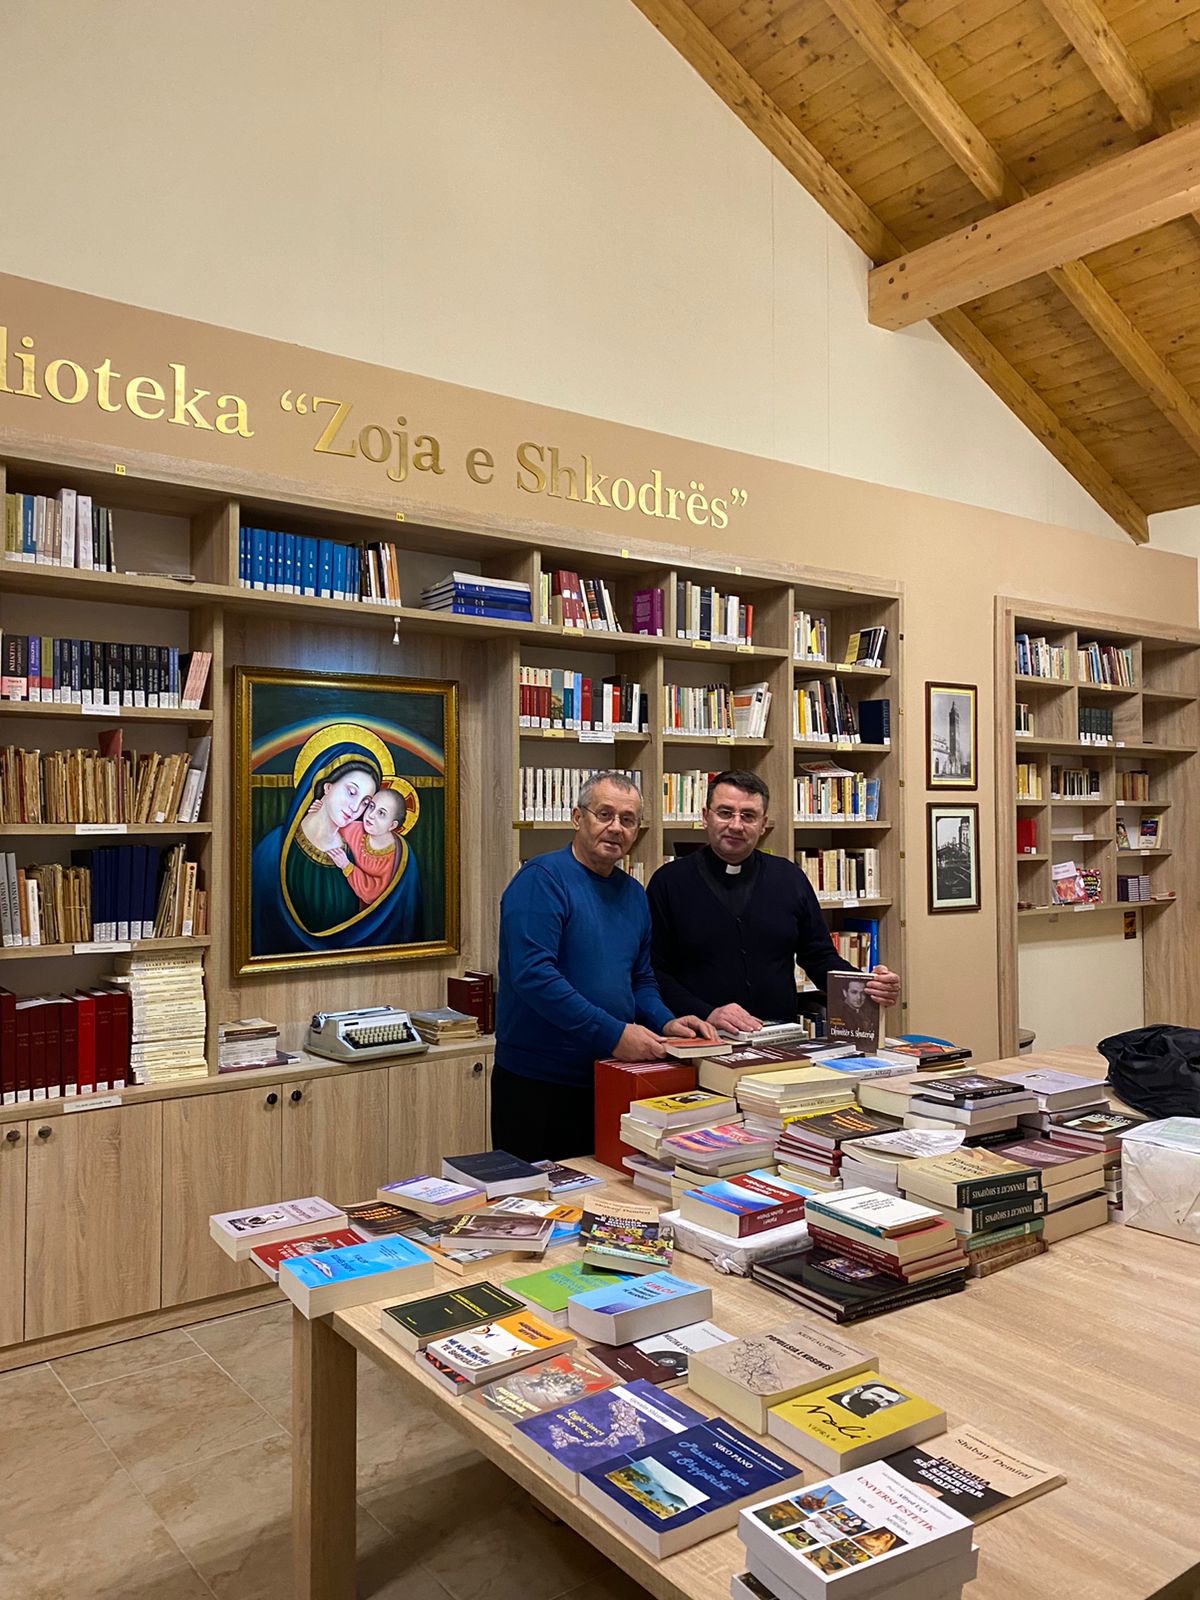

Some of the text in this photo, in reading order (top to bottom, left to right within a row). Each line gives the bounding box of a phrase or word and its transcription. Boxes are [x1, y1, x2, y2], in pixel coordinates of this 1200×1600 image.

[466, 448, 495, 485] e
[710, 1441, 755, 1469] NIKO PANO
[952, 1437, 992, 1459] Shaban
[855, 1476, 898, 1505] UNIVERSI
[895, 1504, 936, 1532] ESTETIK
